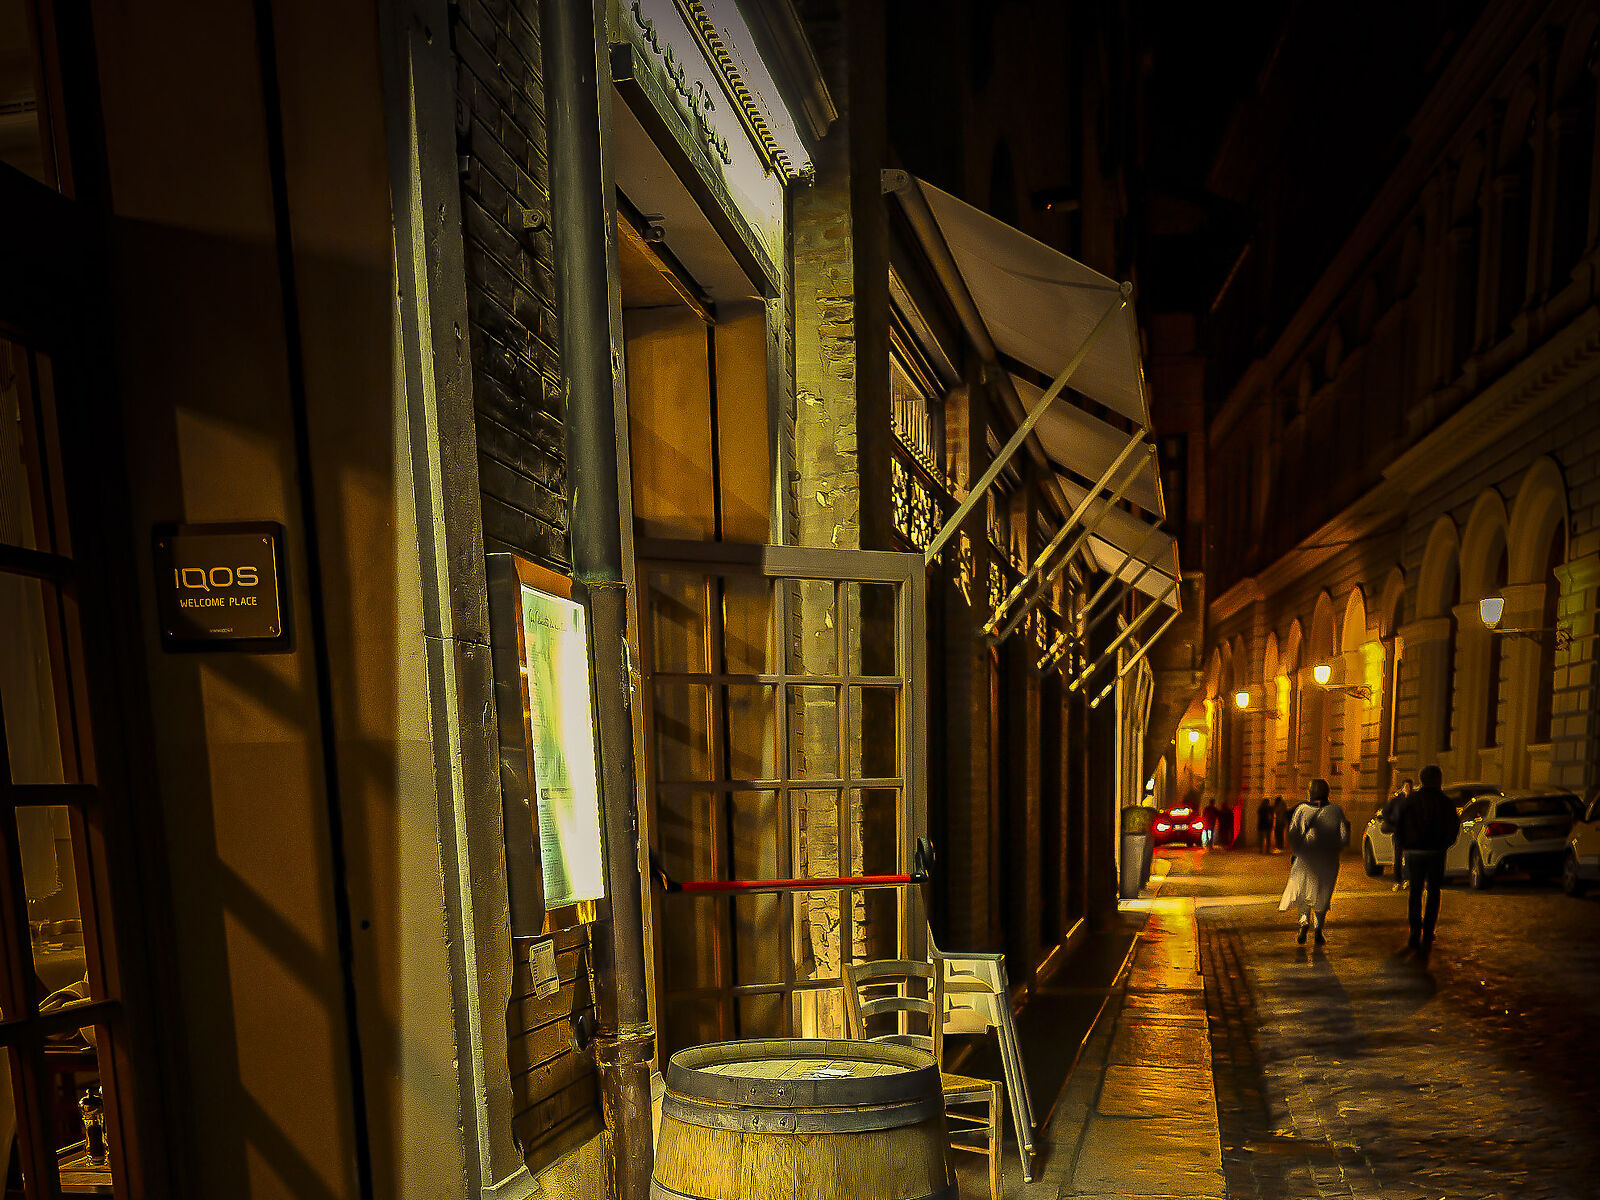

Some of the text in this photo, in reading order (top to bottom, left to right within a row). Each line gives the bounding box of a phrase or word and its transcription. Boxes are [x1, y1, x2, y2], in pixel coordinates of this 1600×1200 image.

[174, 566, 259, 592] IQOS
[179, 596, 258, 608] WELCOME PLACE
